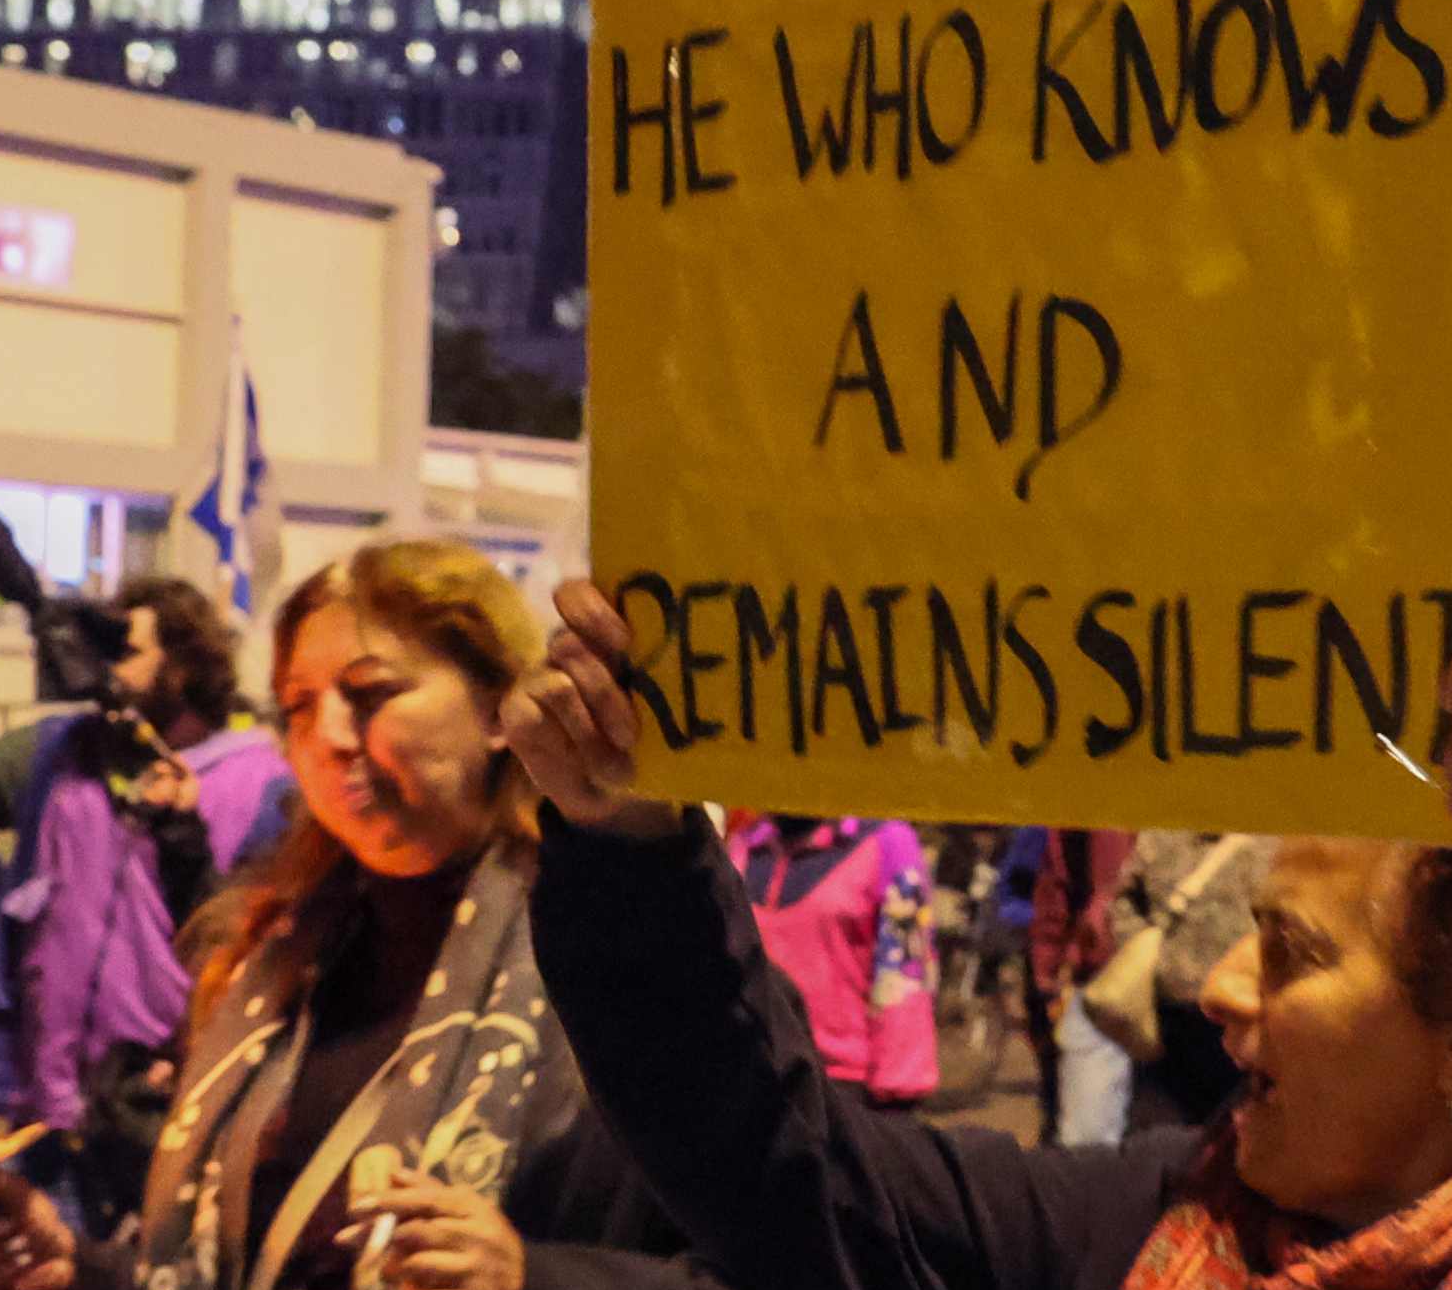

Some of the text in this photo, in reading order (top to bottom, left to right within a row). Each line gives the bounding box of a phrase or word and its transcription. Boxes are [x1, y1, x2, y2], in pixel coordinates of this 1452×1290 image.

[610, 27, 738, 209] HE
[772, 9, 989, 183] WHO
[812, 287, 1124, 502] AND
[613, 568, 1060, 767] REMAINS
